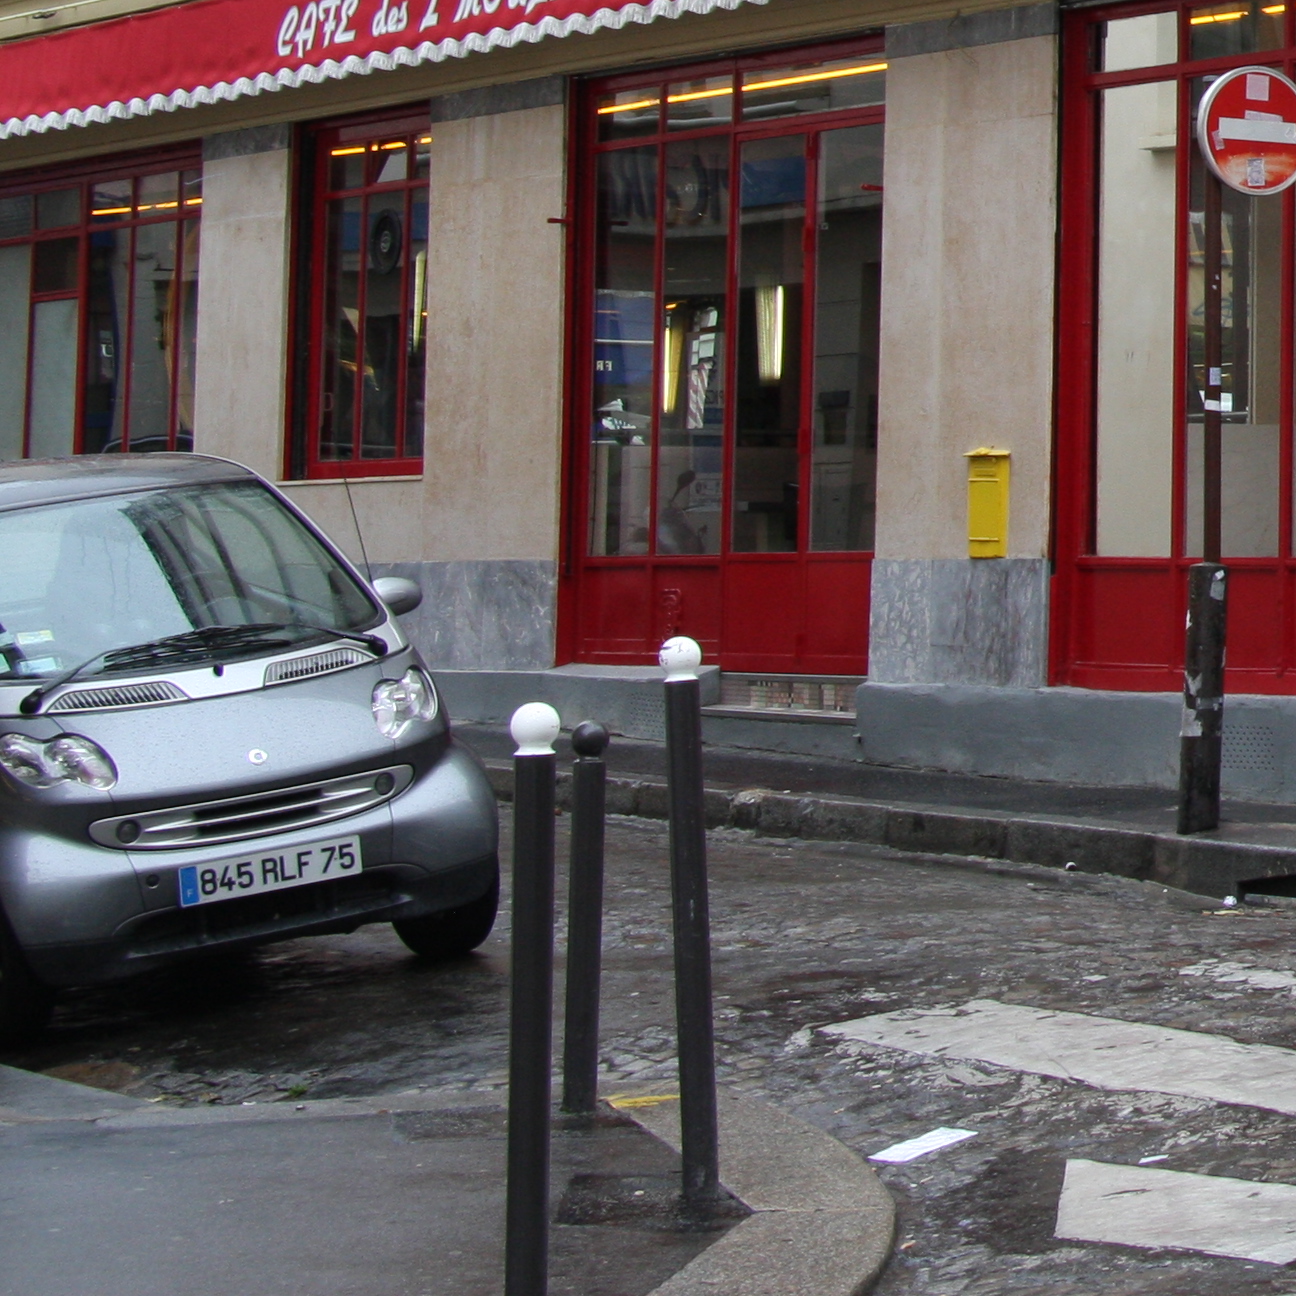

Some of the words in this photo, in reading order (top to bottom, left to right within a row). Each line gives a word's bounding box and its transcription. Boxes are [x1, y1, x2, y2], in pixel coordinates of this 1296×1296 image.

[200, 861, 254, 896] 845
[261, 850, 313, 885] RLF
[321, 843, 356, 874] 75
